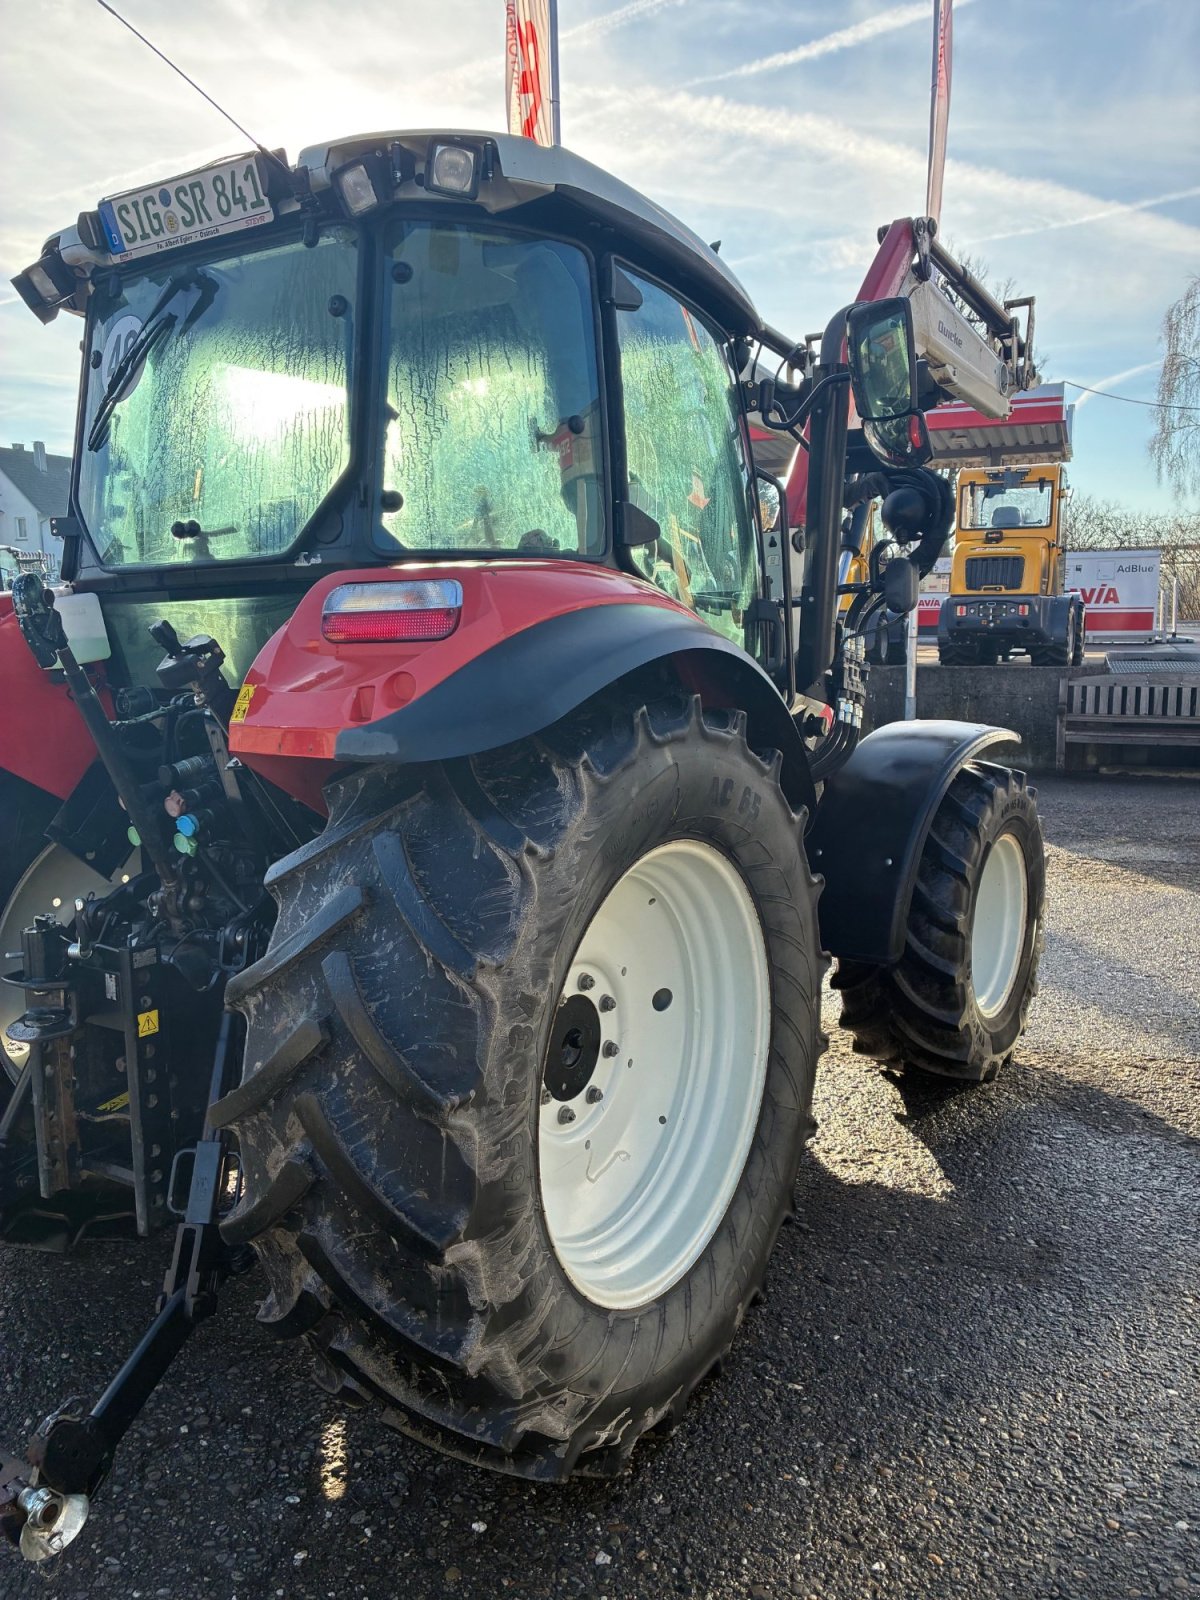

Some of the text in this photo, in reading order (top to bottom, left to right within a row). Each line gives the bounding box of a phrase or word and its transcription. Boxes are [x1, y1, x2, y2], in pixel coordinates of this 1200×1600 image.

[118, 164, 266, 244] SIG SR 841
[245, 216, 266, 227] STEYR
[112, 233, 119, 245] D
[938, 320, 963, 348] Quicke
[1116, 564, 1154, 574] AdBlue
